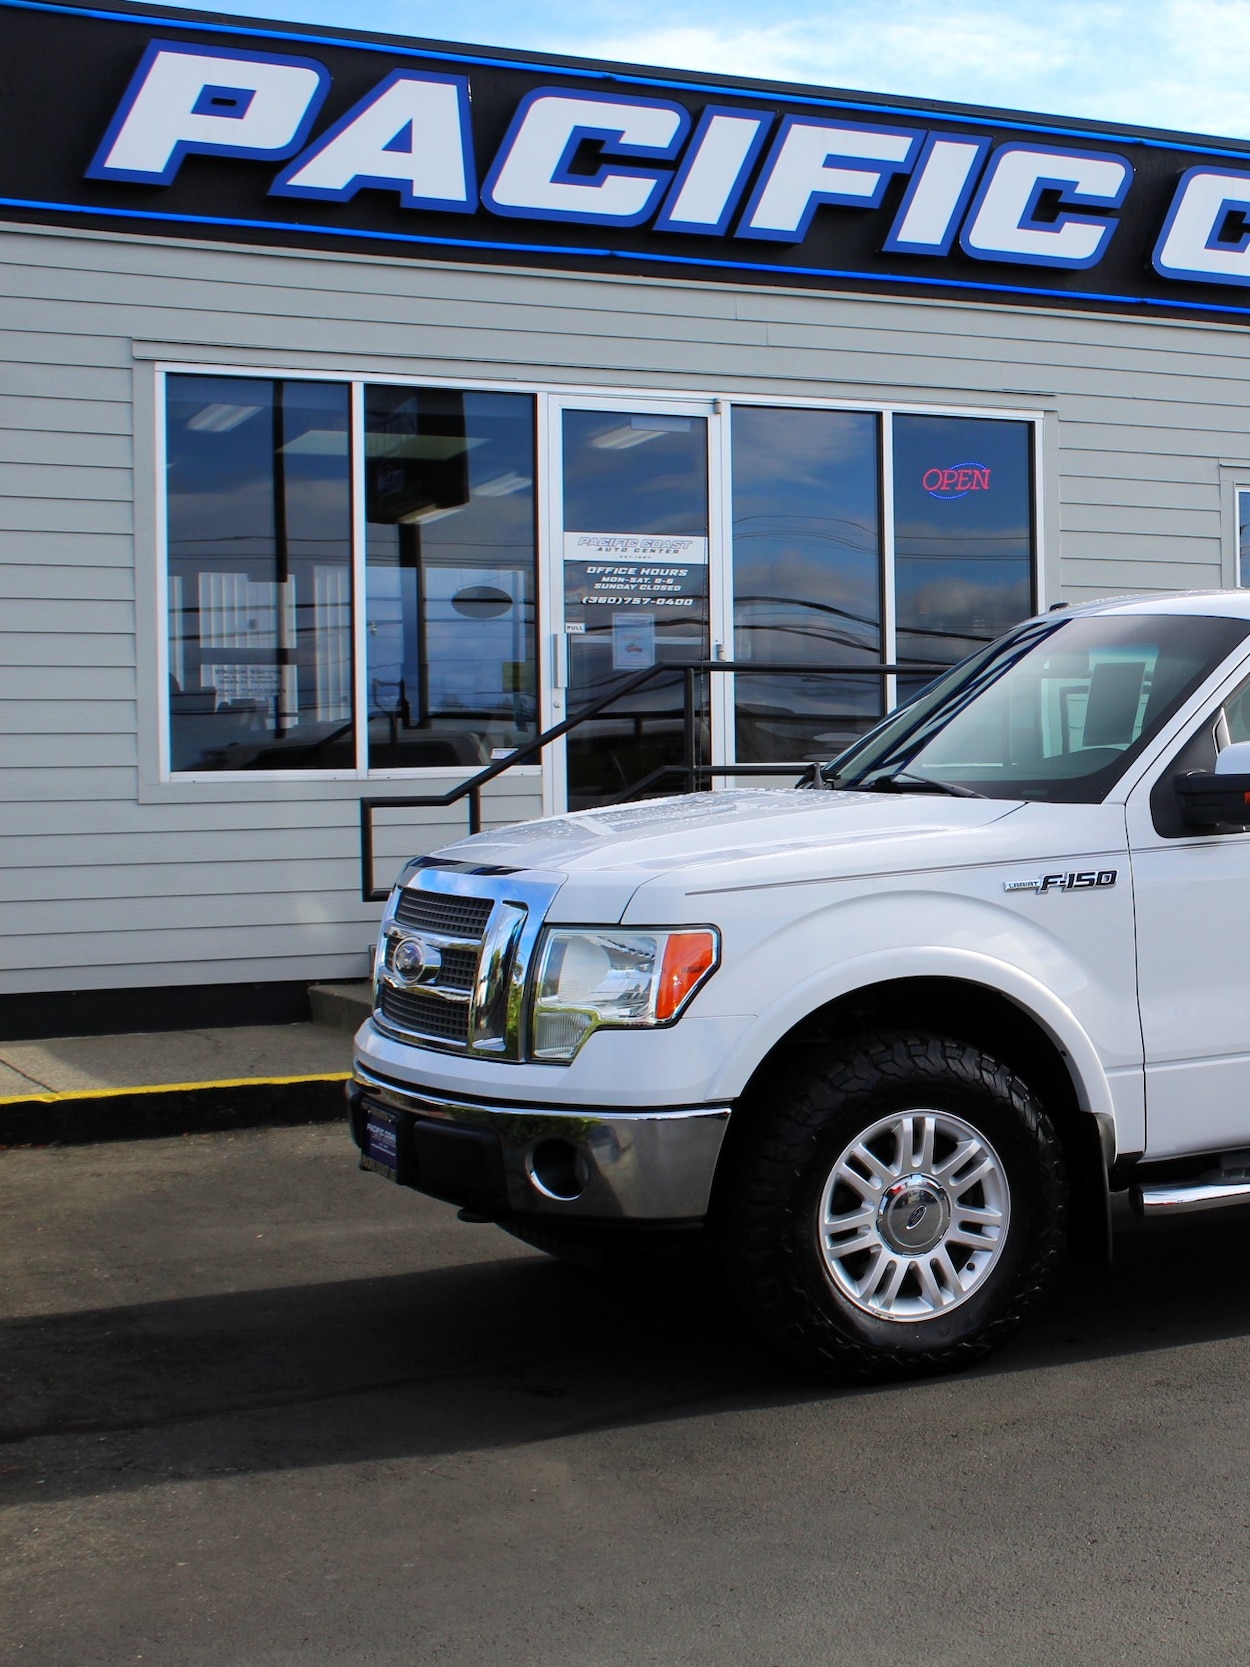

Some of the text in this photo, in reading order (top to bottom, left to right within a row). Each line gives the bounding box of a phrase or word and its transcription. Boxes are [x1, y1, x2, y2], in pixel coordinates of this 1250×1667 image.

[84, 38, 1134, 270] PACIFIC
[922, 468, 991, 491] OPEN
[577, 536, 693, 549] PACIFIC COAST
[586, 566, 689, 577] OFFICE HOURS
[601, 576, 651, 584] MON-SAT.
[594, 583, 682, 592] SUNDAY CLOSED
[1038, 869, 1119, 893] F-150
